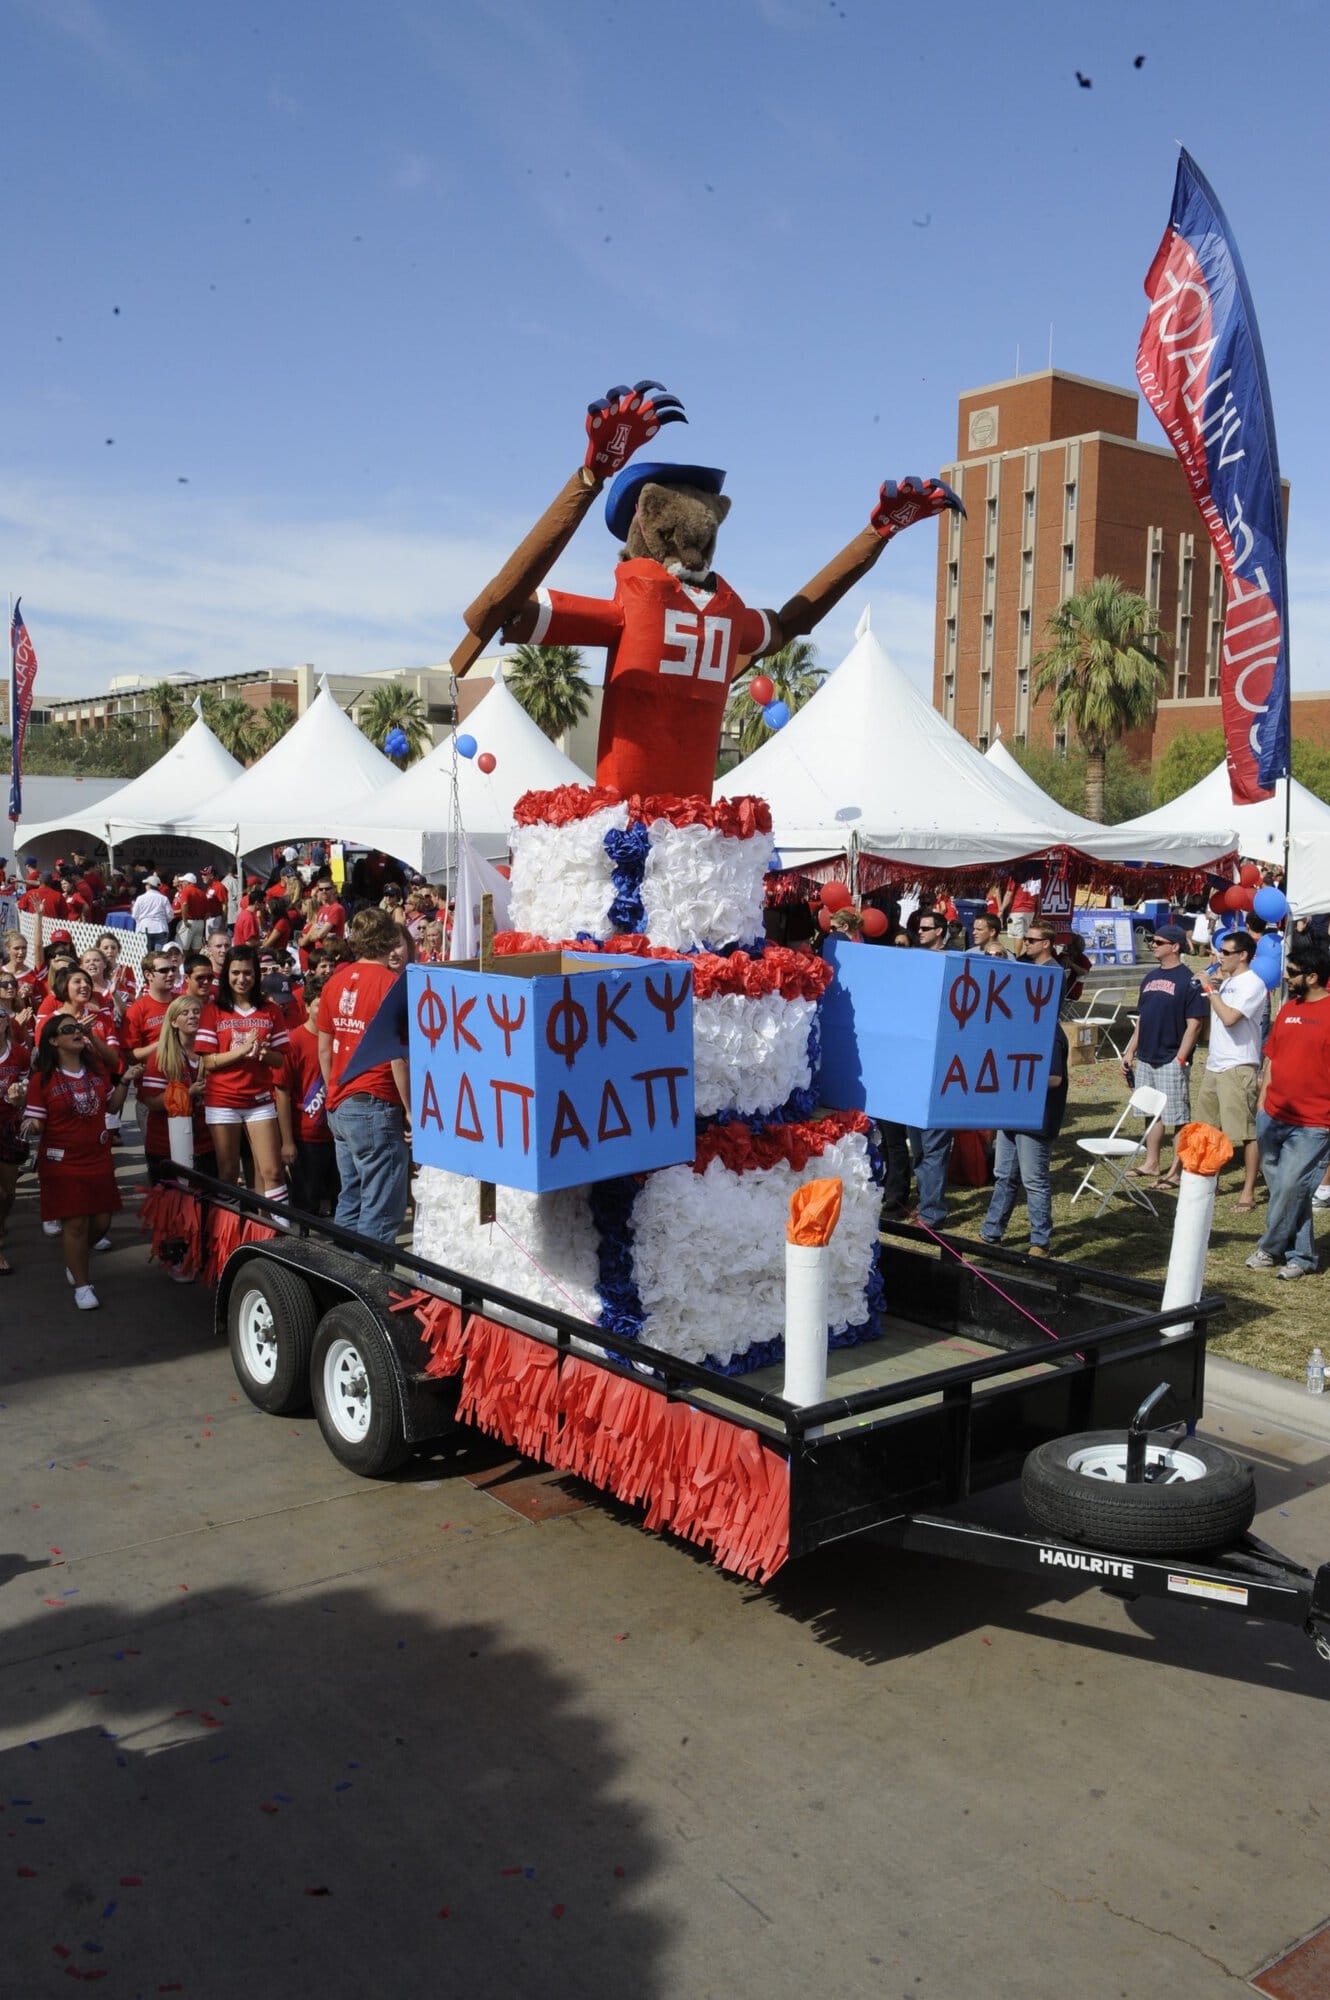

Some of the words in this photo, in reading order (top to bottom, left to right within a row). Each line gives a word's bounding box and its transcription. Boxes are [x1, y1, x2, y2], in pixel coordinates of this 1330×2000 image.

[606, 424, 632, 454] A
[659, 608, 732, 683] 50
[1039, 1548, 1133, 1578] HAULRITE
